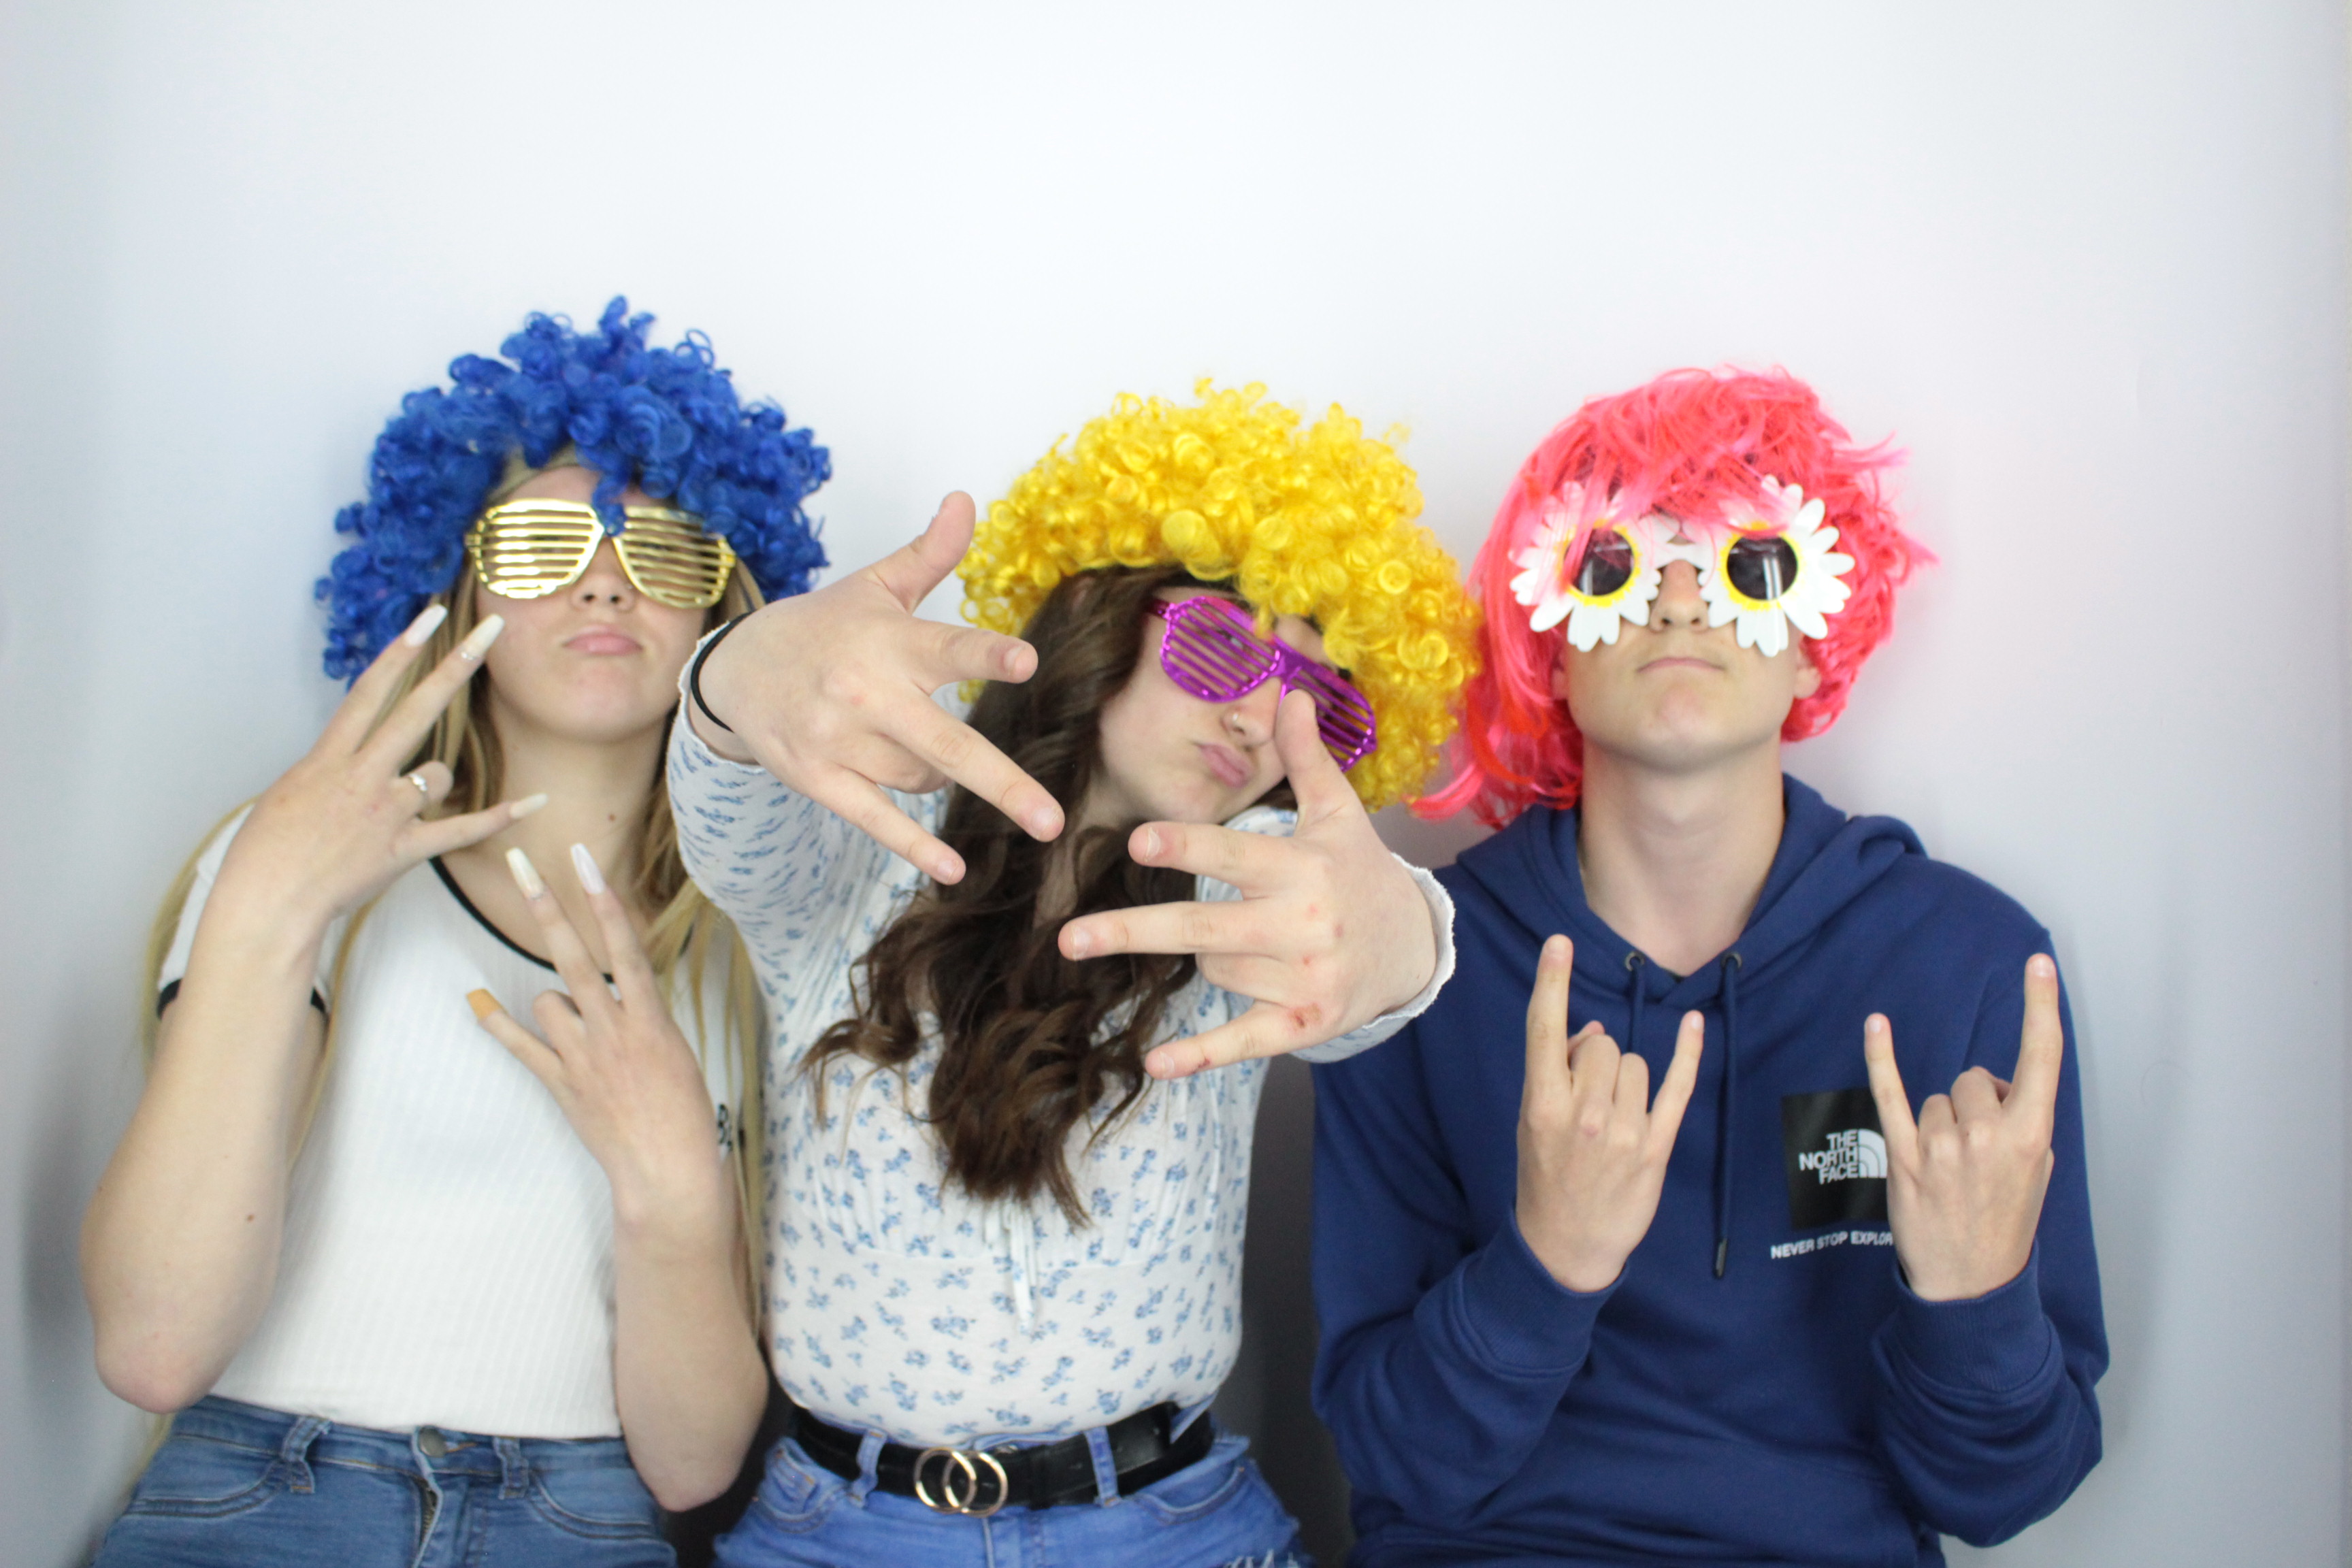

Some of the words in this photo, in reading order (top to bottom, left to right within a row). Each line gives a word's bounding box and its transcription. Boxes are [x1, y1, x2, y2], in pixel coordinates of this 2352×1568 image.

[1827, 1130, 1858, 1148] THE
[1799, 1147, 1858, 1171] NORTH
[1819, 1162, 1858, 1185] FACE
[1771, 1239, 1814, 1259] NEVER
[1816, 1231, 1848, 1250] STOP
